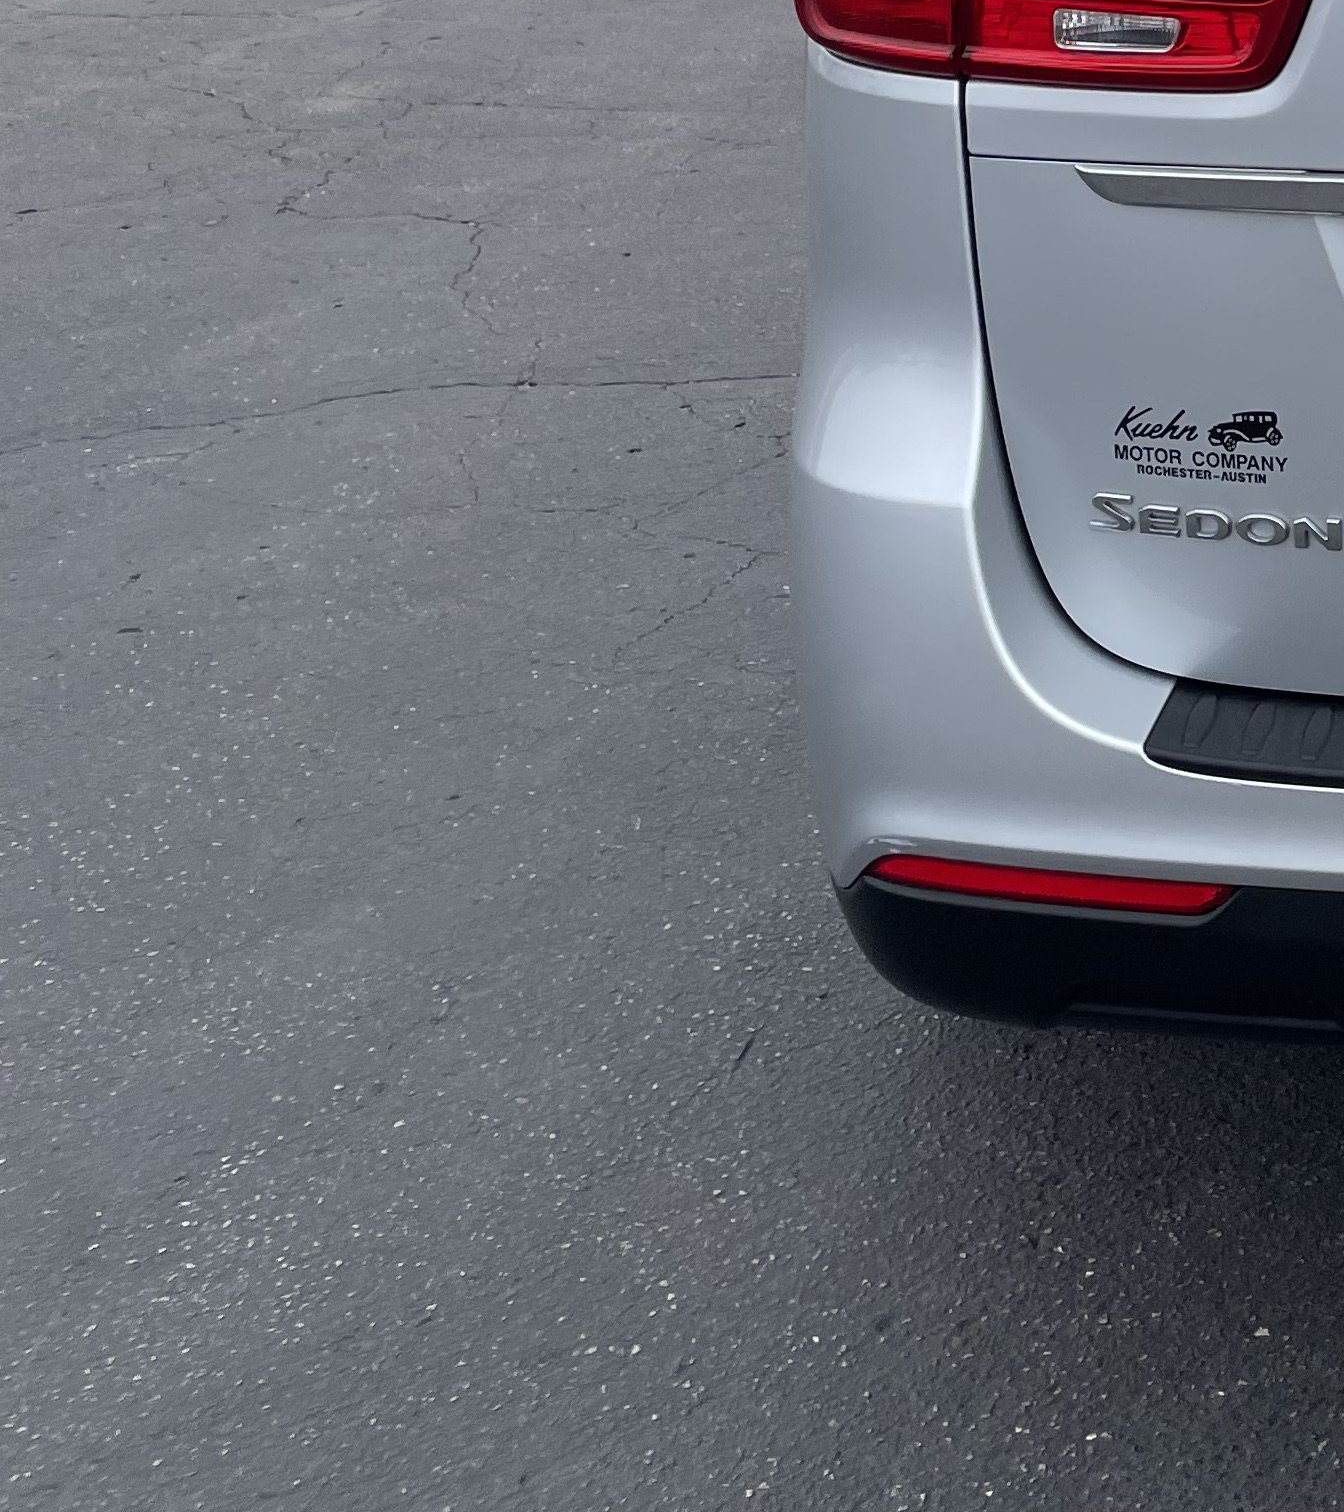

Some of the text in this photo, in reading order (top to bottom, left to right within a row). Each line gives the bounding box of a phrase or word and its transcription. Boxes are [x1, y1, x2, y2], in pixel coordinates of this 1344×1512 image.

[1114, 405, 1199, 442] Kuehn
[1114, 443, 1288, 473] MOTOR COMPANY
